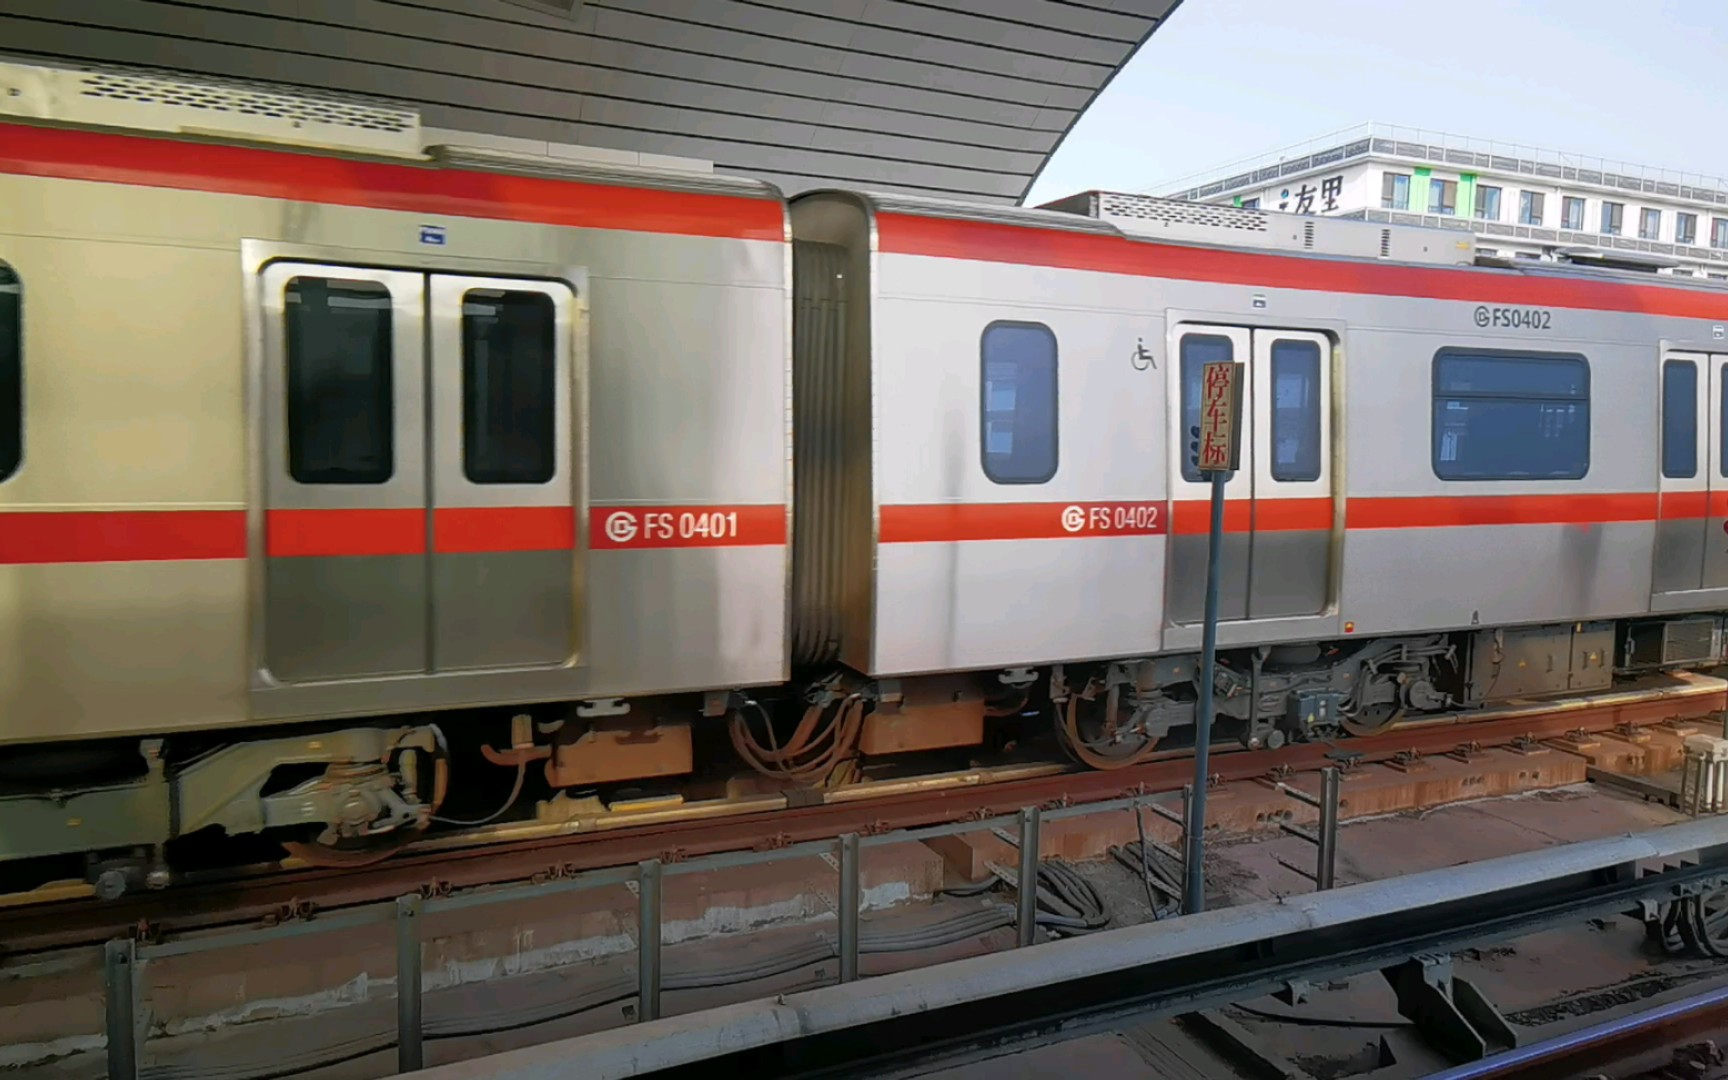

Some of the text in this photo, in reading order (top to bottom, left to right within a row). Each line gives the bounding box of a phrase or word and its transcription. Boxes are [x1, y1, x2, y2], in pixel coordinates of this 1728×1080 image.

[1492, 307, 1552, 330] FS0402
[1203, 364, 1230, 465] 停车标
[643, 511, 737, 540] FS 0401
[1089, 506, 1158, 530] FS 0402
